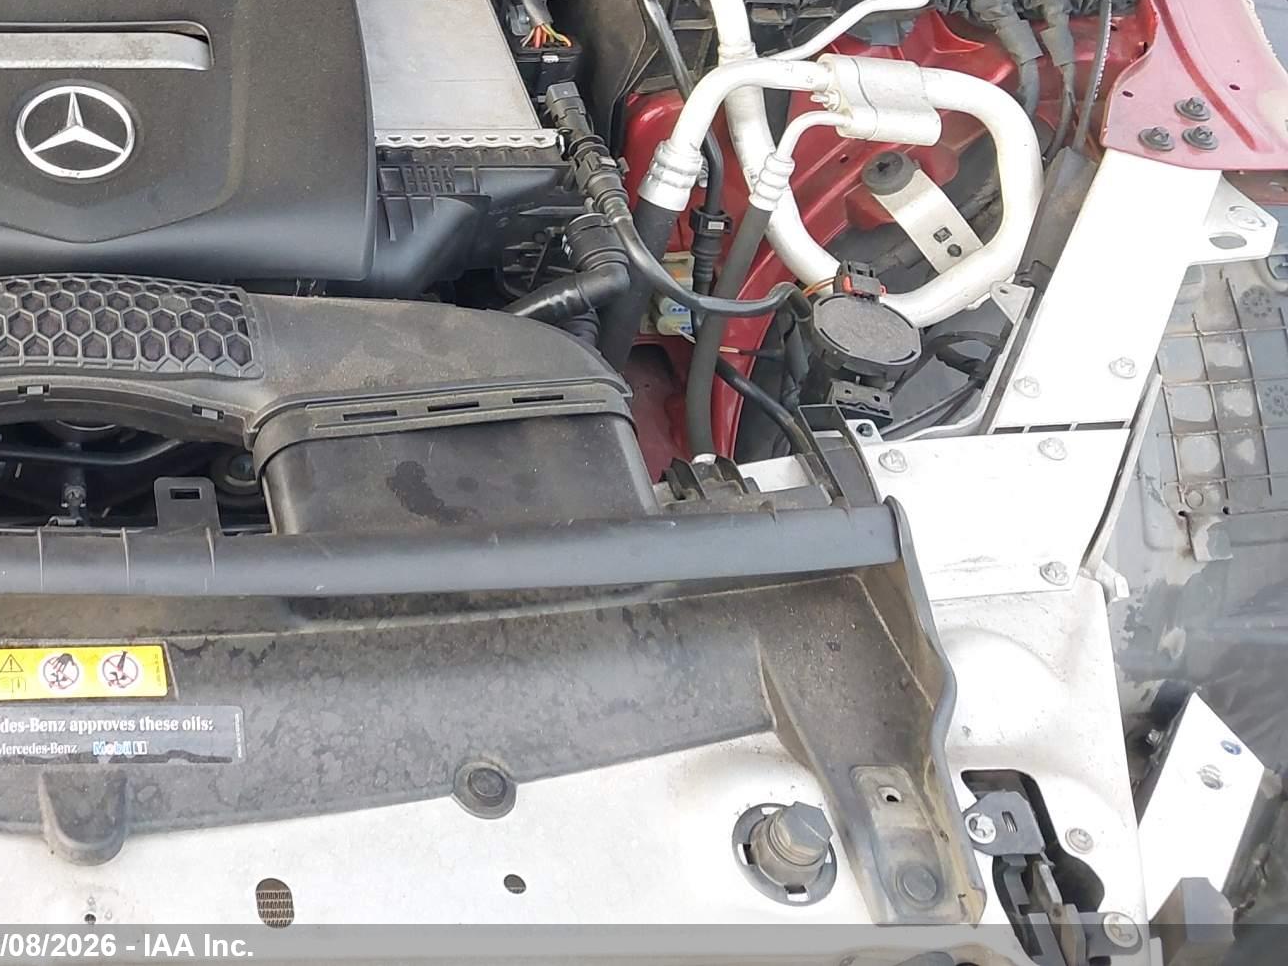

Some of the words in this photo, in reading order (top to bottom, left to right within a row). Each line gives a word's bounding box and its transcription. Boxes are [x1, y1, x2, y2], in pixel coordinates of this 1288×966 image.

[69, 719, 136, 734] approves
[139, 716, 179, 731] these
[182, 715, 214, 731] oils:
[93, 740, 132, 755] Mobil
